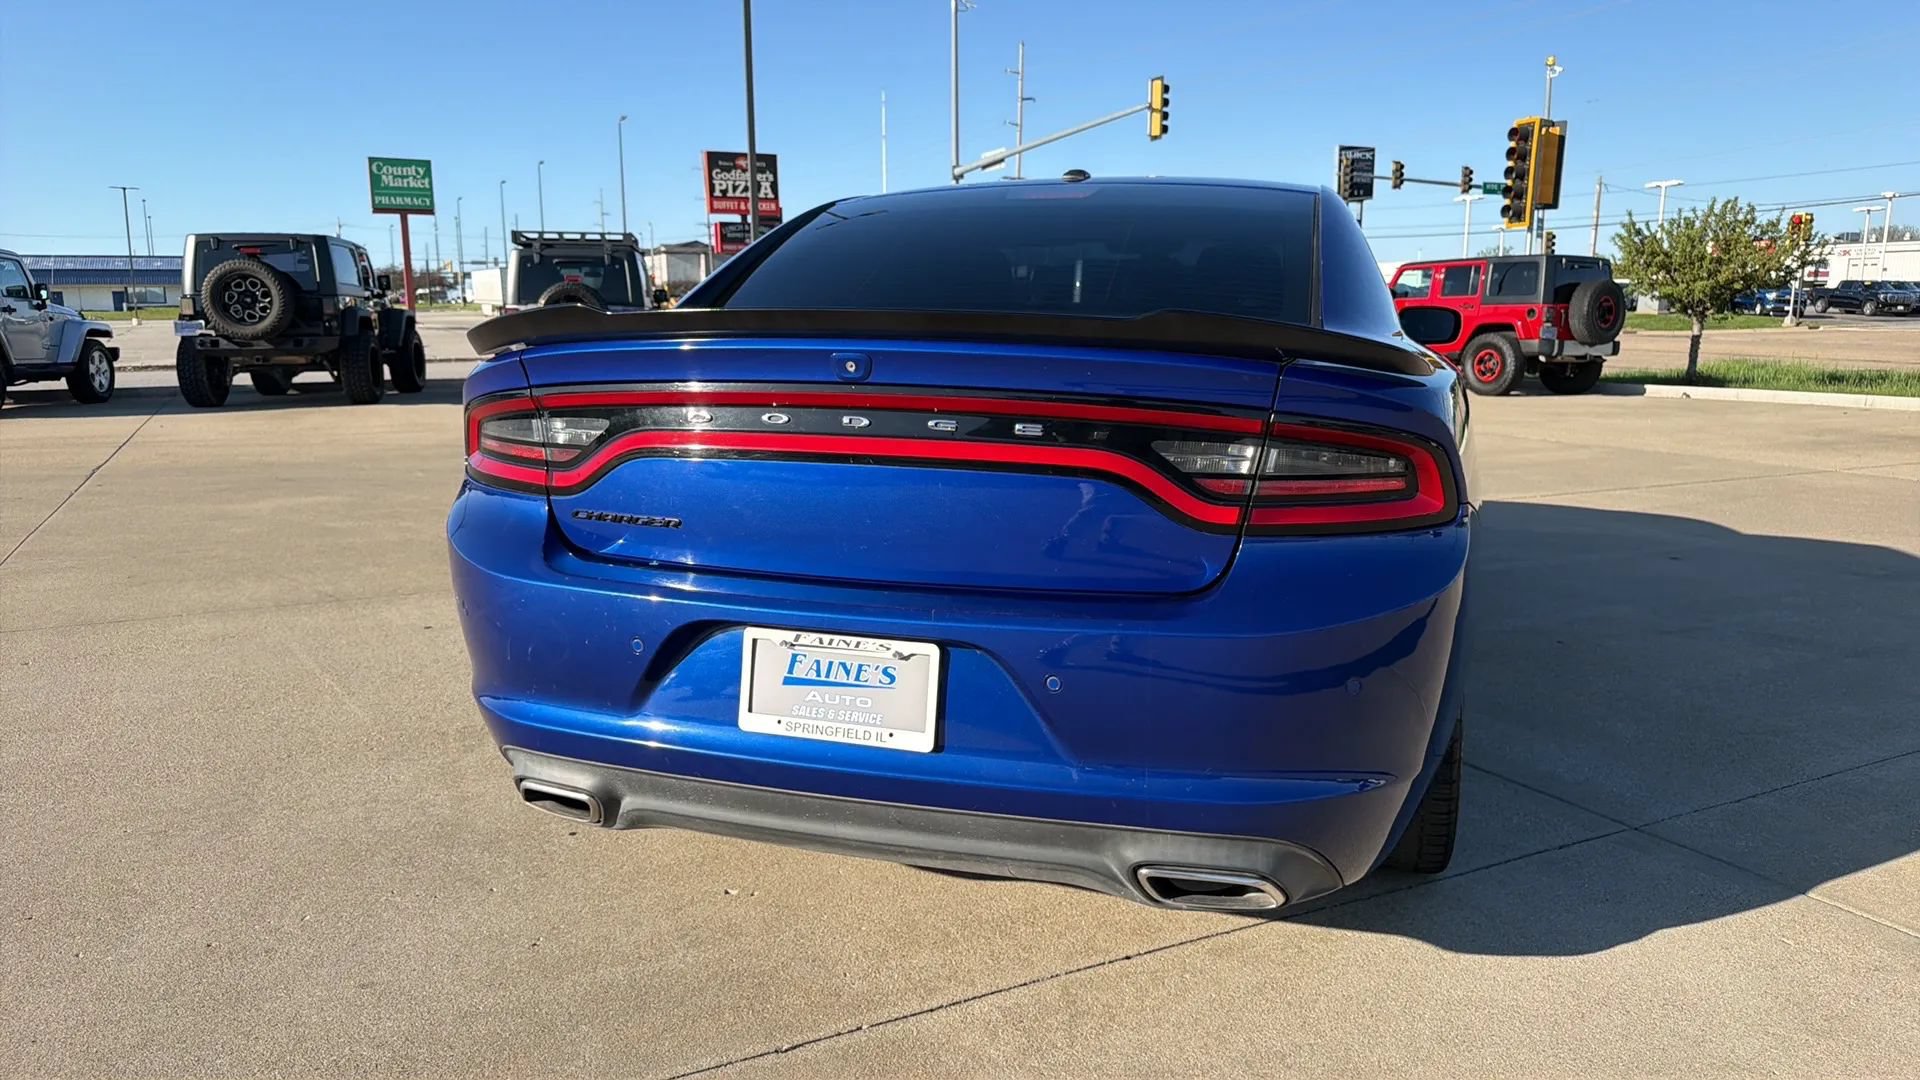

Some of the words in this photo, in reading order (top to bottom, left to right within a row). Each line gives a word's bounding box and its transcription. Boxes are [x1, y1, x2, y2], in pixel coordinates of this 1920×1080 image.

[371, 161, 426, 177] County
[712, 169, 774, 182] Godfater's
[380, 174, 430, 188] Market
[712, 180, 775, 198] PIZA
[374, 195, 431, 206] PHARMACY
[686, 404, 1044, 436] DODGE
[573, 510, 682, 529] CHARGER
[793, 633, 892, 652] FAINE'S
[786, 653, 897, 686] FAINE'S
[805, 690, 872, 707] AUTO
[791, 704, 825, 718] SALES
[827, 708, 835, 719] &
[836, 710, 884, 725] SERVICE
[785, 721, 872, 741] SPRINGFIELD
[875, 732, 887, 743] IL
